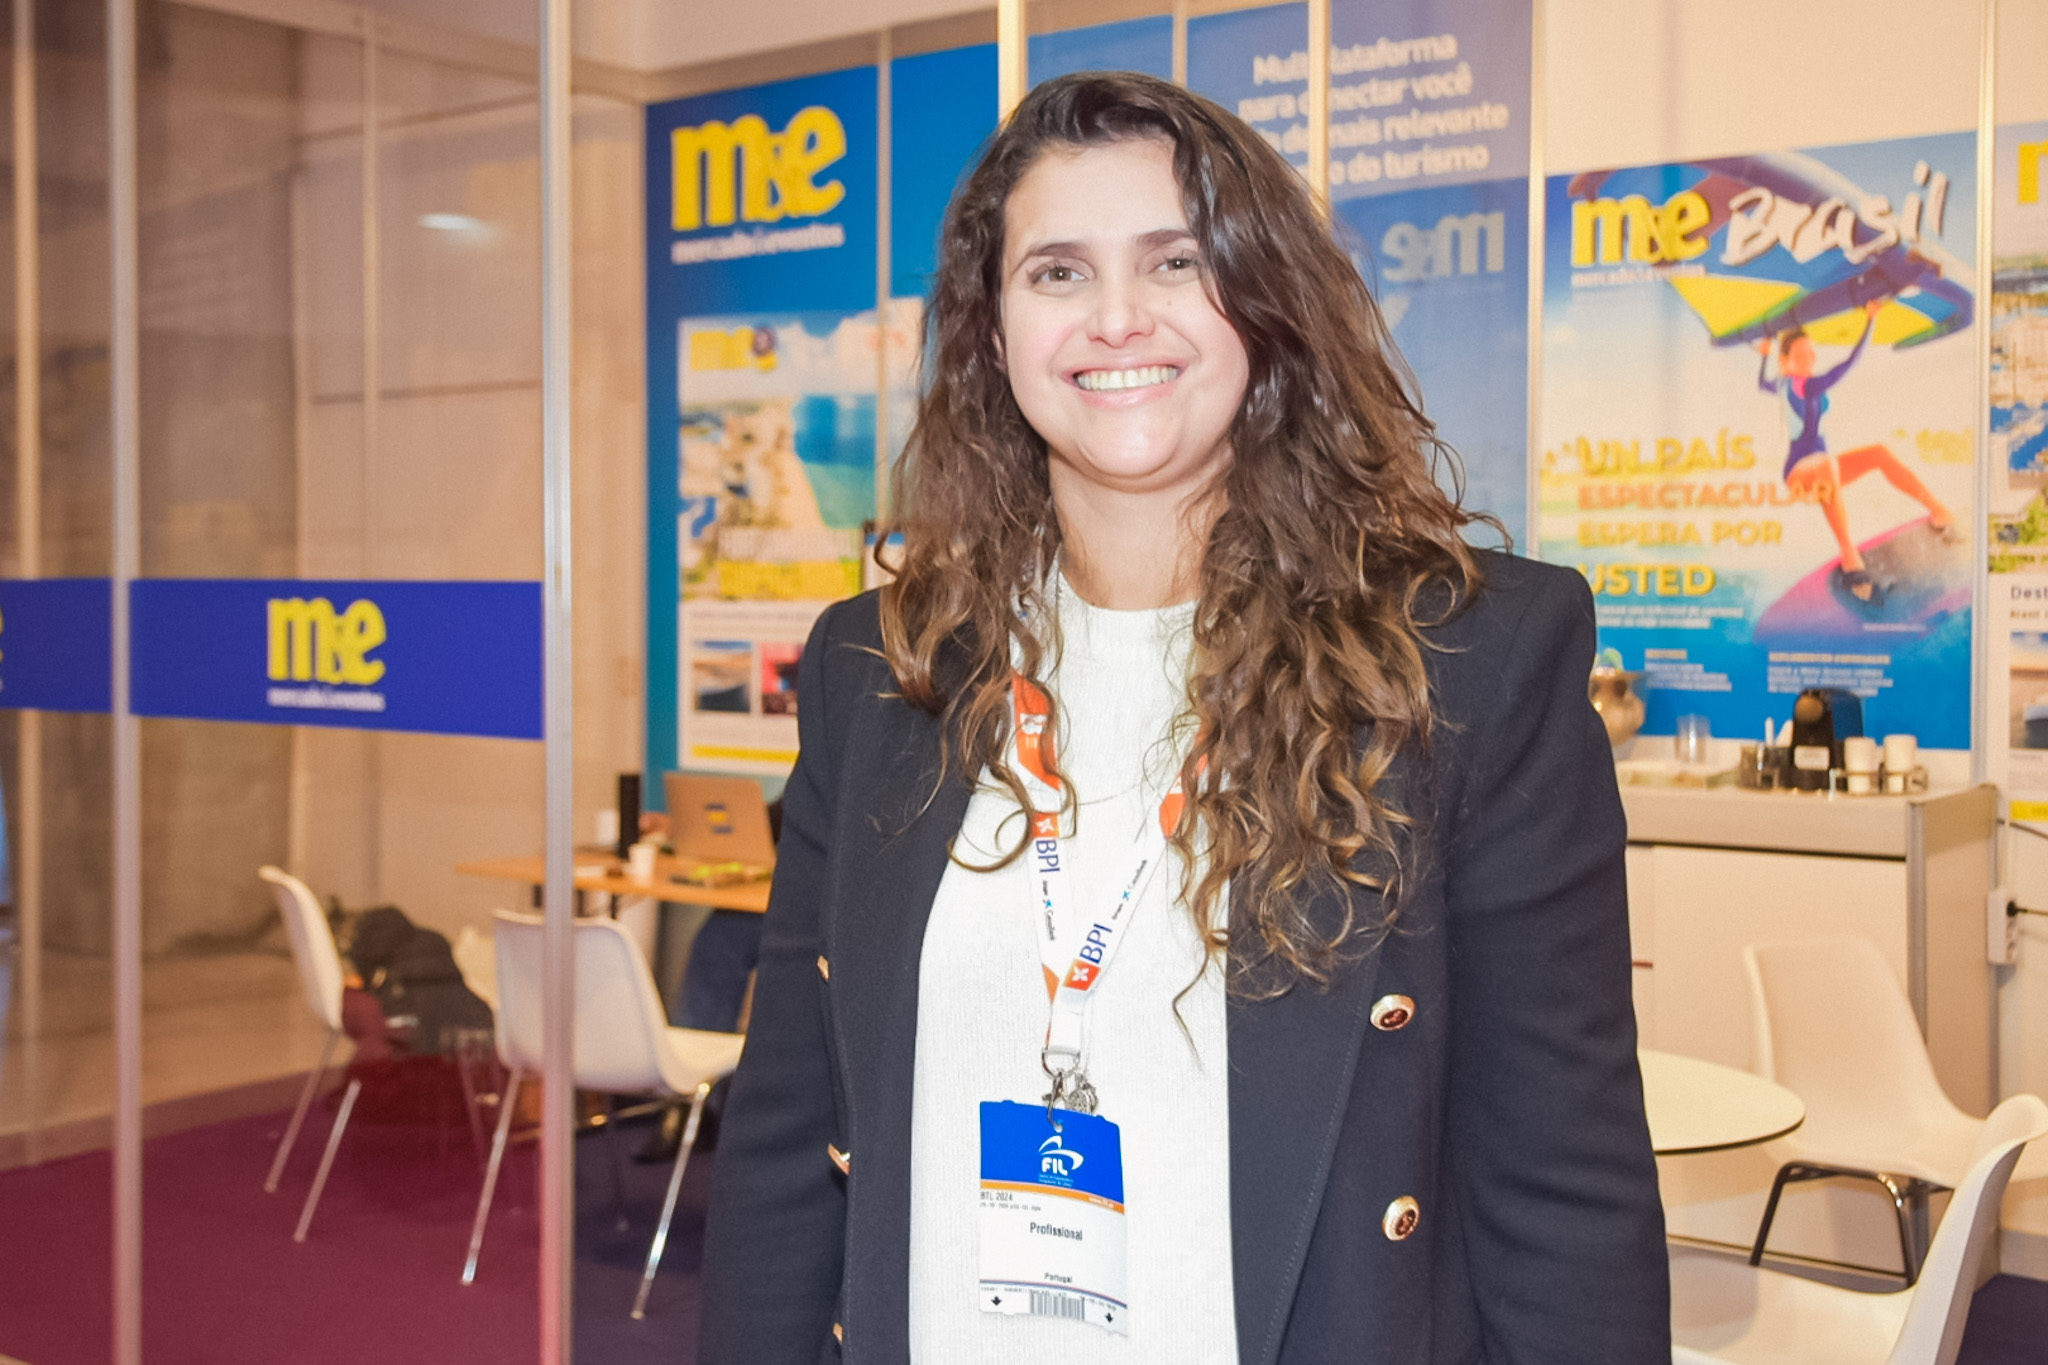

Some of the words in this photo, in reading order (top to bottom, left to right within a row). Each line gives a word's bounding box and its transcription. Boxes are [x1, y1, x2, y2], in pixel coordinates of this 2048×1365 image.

[1411, 61, 1474, 100] você
[1383, 101, 1510, 142] relevante
[1384, 144, 1491, 179] turismo
[1720, 160, 1949, 266] Brasil
[1655, 428, 1757, 471] PAÍS
[1576, 520, 1702, 547] ESPERA
[1711, 519, 1783, 546] POR
[1036, 839, 1060, 873] BPI
[1079, 922, 1112, 965] BPI
[1041, 1156, 1069, 1177] FIL
[980, 1191, 993, 1201] BTL
[996, 1192, 1013, 1202] 2024
[1030, 1222, 1083, 1241] Profissional
[1045, 1273, 1073, 1283] Portugal
